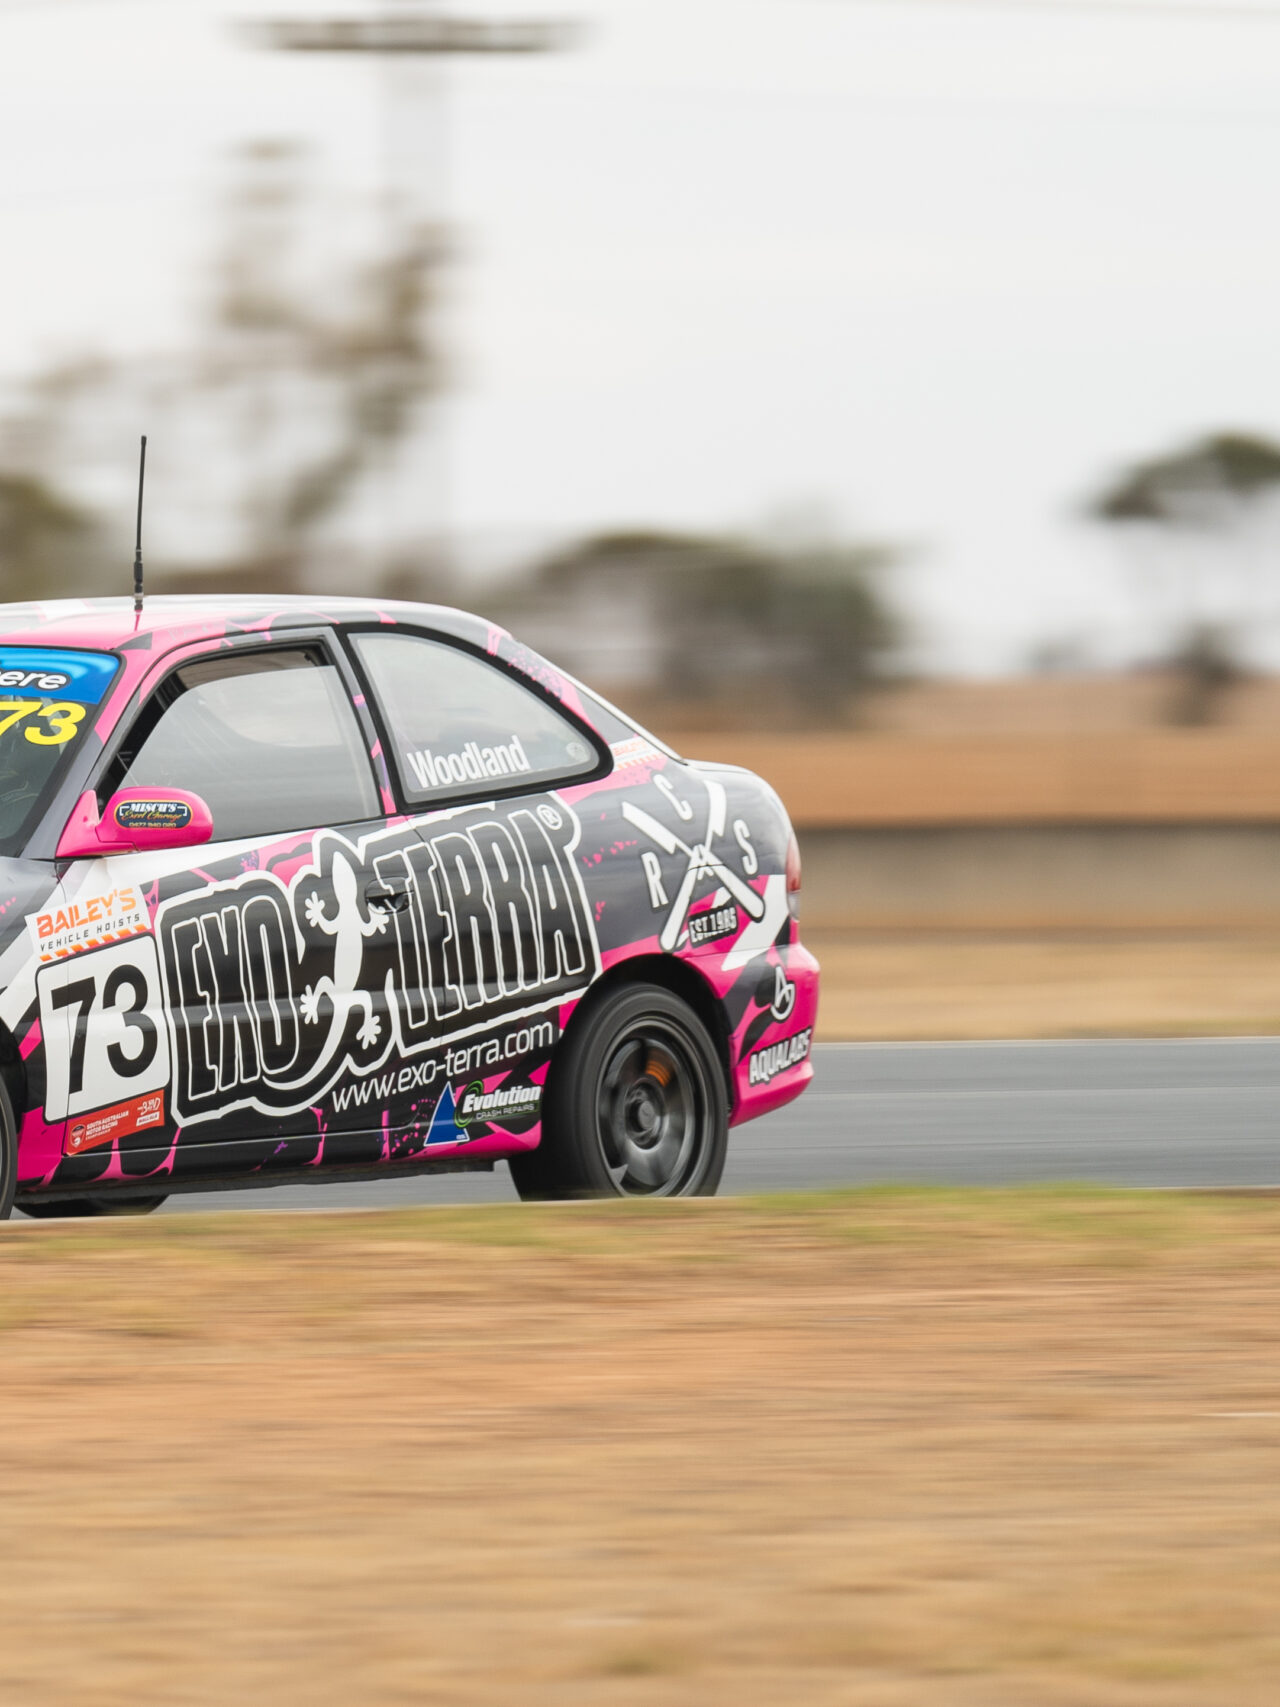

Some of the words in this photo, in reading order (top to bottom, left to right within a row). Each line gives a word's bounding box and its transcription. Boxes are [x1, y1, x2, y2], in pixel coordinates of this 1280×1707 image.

[406, 735, 532, 788] Woodland
[641, 851, 669, 908] R
[36, 888, 137, 939] BAILEY'S
[40, 929, 89, 952] VEHICLE
[96, 913, 140, 934] HOISTS
[171, 895, 300, 1101] EXO
[51, 964, 158, 1095] 73
[749, 1028, 811, 1084] AQUALABS
[332, 1021, 553, 1113] www.exo-terra.com
[462, 1085, 542, 1114] Evolution
[476, 1108, 502, 1120] CRASH
[503, 1103, 535, 1115] REPAIRS
